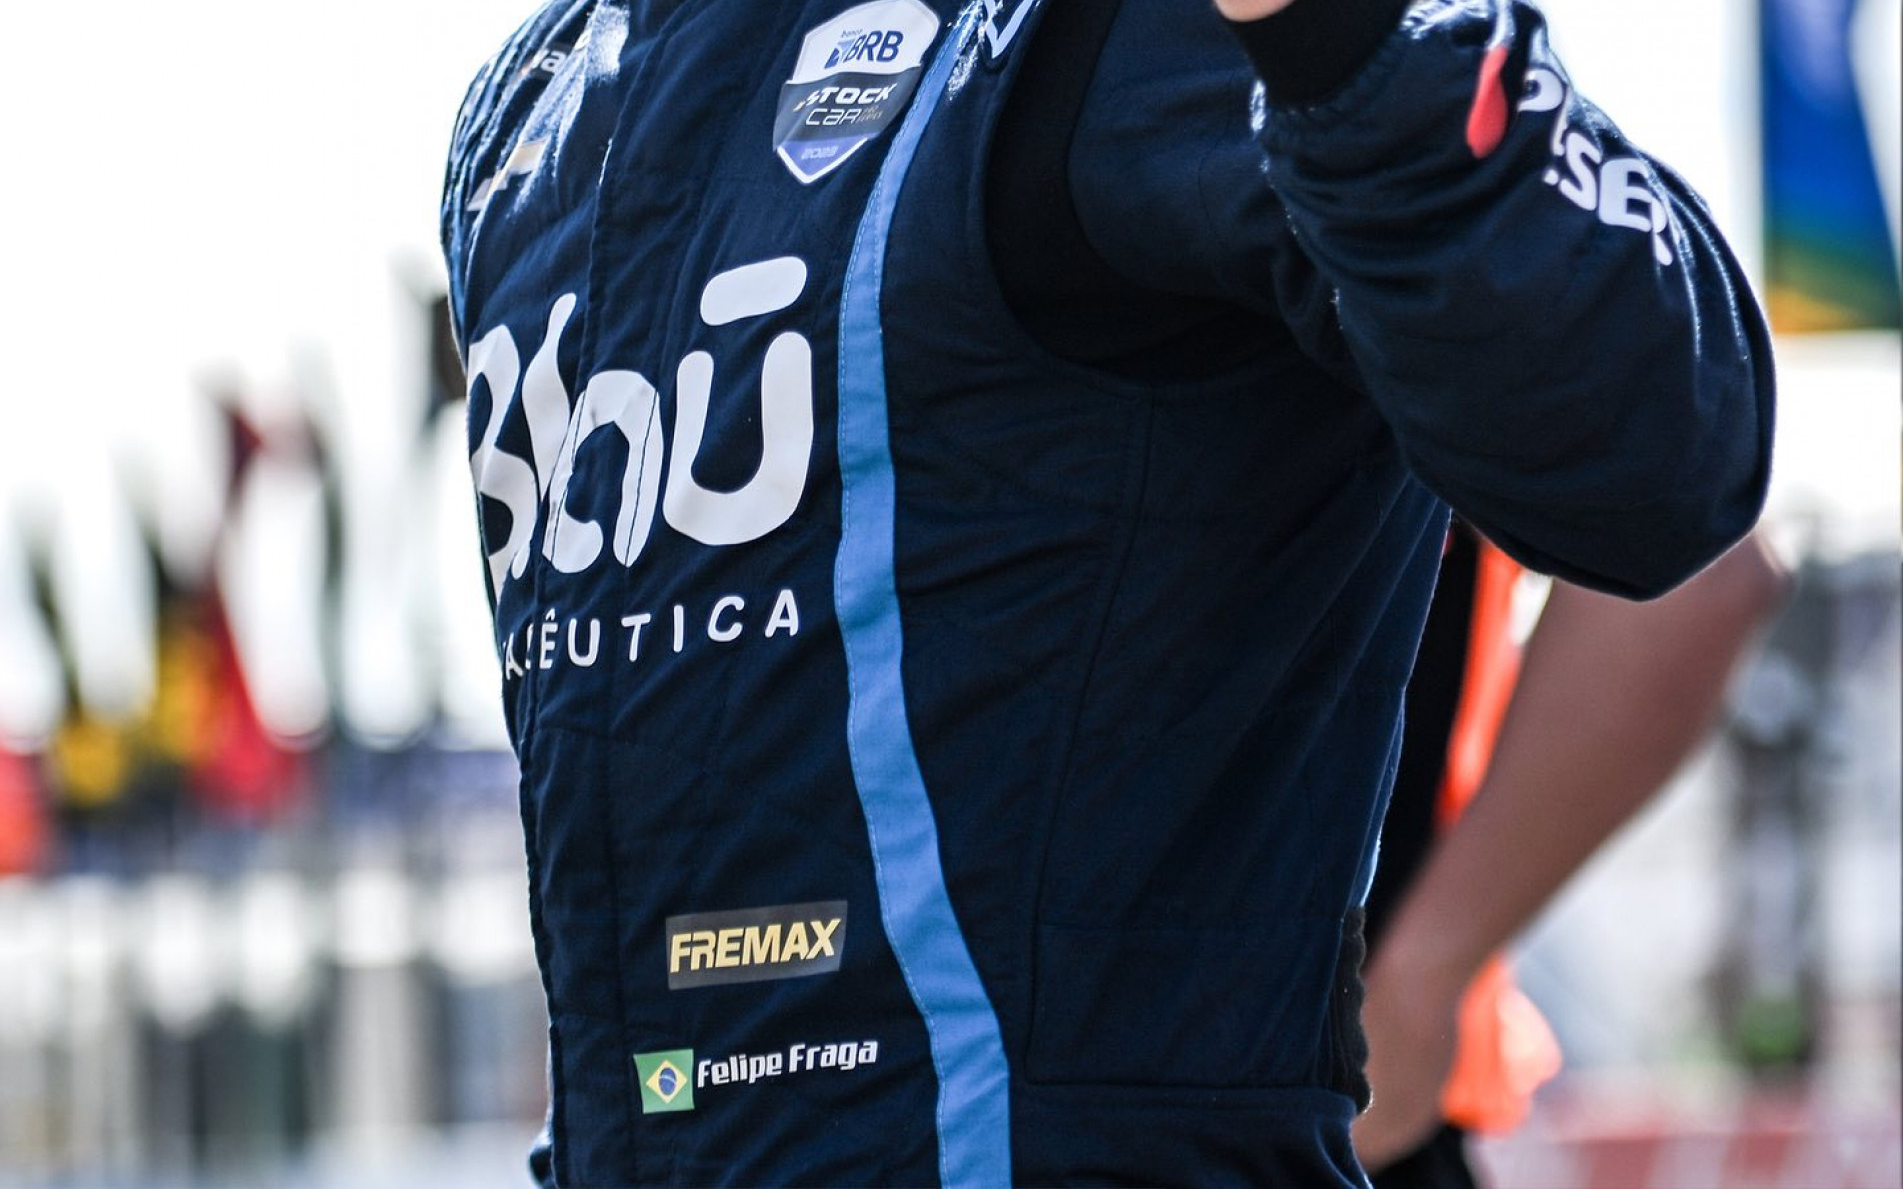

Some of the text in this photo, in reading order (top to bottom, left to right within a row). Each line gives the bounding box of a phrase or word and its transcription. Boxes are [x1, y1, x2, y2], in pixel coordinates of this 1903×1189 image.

[843, 30, 904, 63] BRB
[805, 83, 898, 106] STOCK
[669, 918, 842, 973] FREMAX
[697, 1040, 879, 1089] Felipe Fraga
